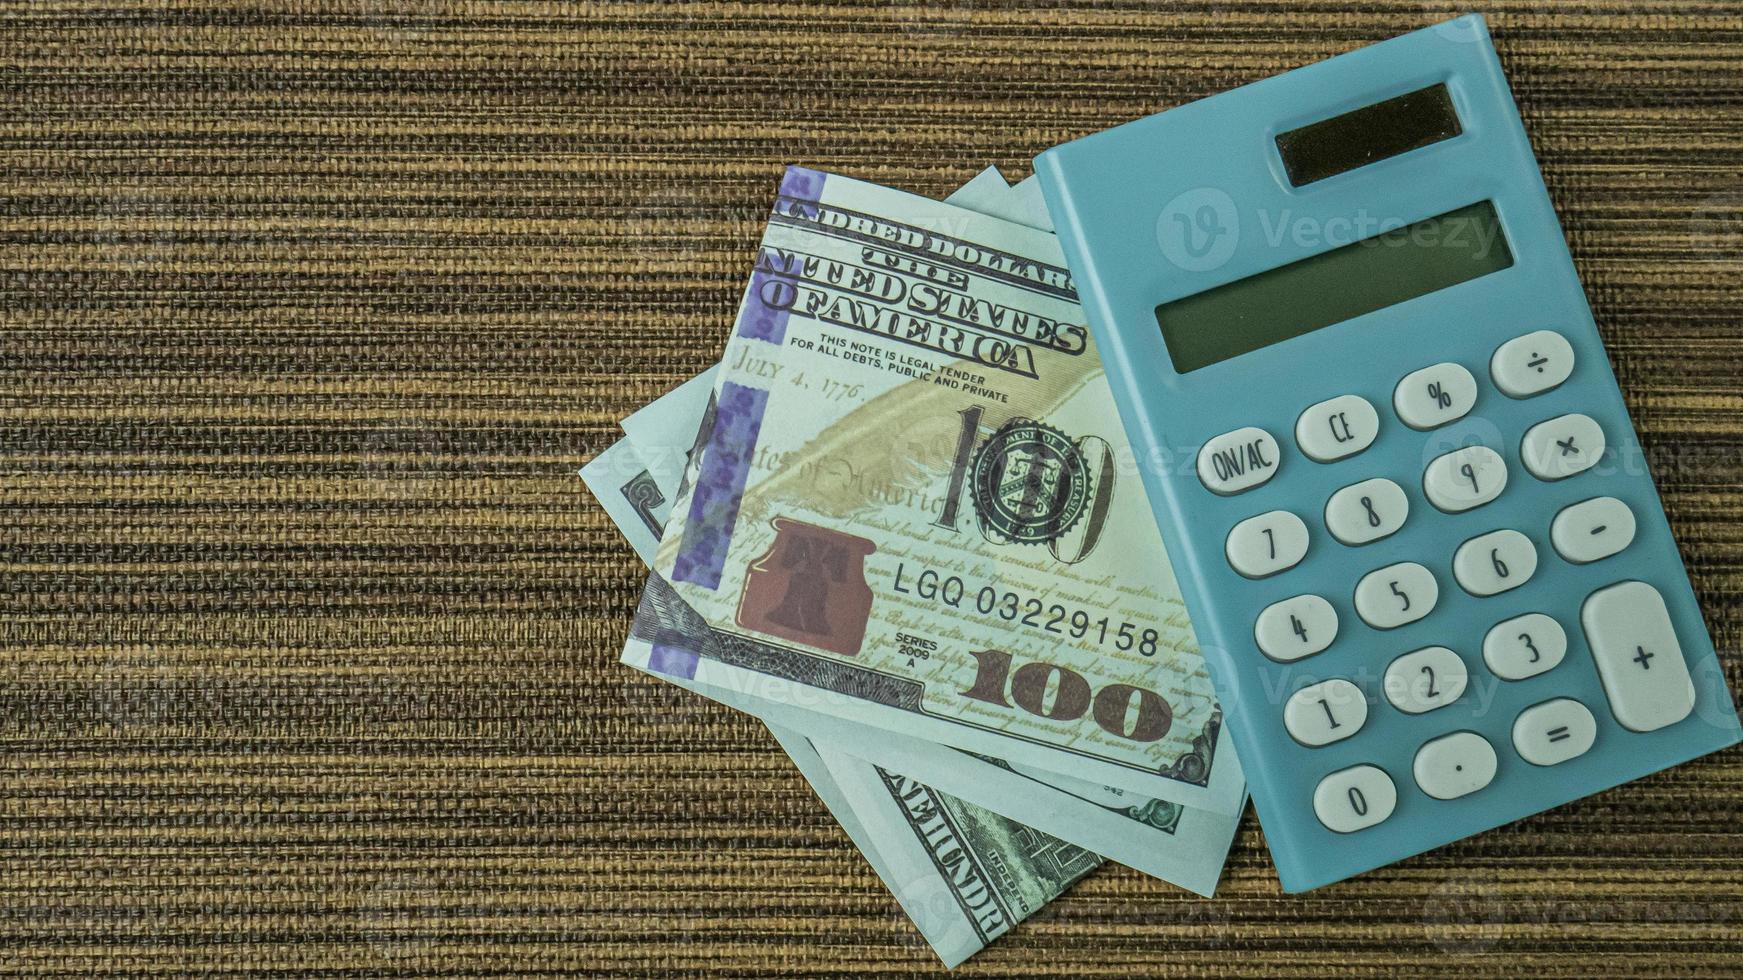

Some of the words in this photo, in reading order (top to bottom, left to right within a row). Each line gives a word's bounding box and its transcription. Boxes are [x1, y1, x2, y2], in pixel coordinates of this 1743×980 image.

[861, 247, 970, 292] THE
[760, 279, 827, 320] OF
[823, 296, 1040, 380] AMERICA
[908, 282, 1088, 356] STATES
[790, 337, 815, 350] FOR
[817, 345, 839, 358] ALL
[843, 351, 884, 370] DEBTS,
[888, 363, 931, 382] PUBLIC
[934, 376, 959, 390] AND
[962, 381, 1009, 403] PRIVATE
[820, 333, 847, 348] THIS
[850, 342, 882, 358] NOTE
[885, 350, 897, 362] IS
[900, 355, 936, 373] LEGAL
[940, 365, 986, 386] TENDER
[1427, 381, 1451, 410] %
[1328, 412, 1355, 443] CE
[1211, 438, 1273, 482] ON/AC
[1461, 463, 1480, 494] 9
[1360, 495, 1381, 528] 8
[1261, 528, 1276, 560] 7
[1491, 548, 1510, 579] 6
[894, 563, 965, 609] LGQ
[976, 585, 1159, 657] 03229158
[1389, 581, 1411, 612] 5
[895, 632, 939, 651] SERIES
[1289, 613, 1309, 644] 4
[898, 645, 930, 661] 2009
[906, 658, 916, 668] A
[1518, 633, 1541, 664] 3
[958, 648, 1174, 744] 100
[1421, 665, 1440, 698] 2
[1317, 698, 1341, 730] 1
[1347, 786, 1368, 817] 0
